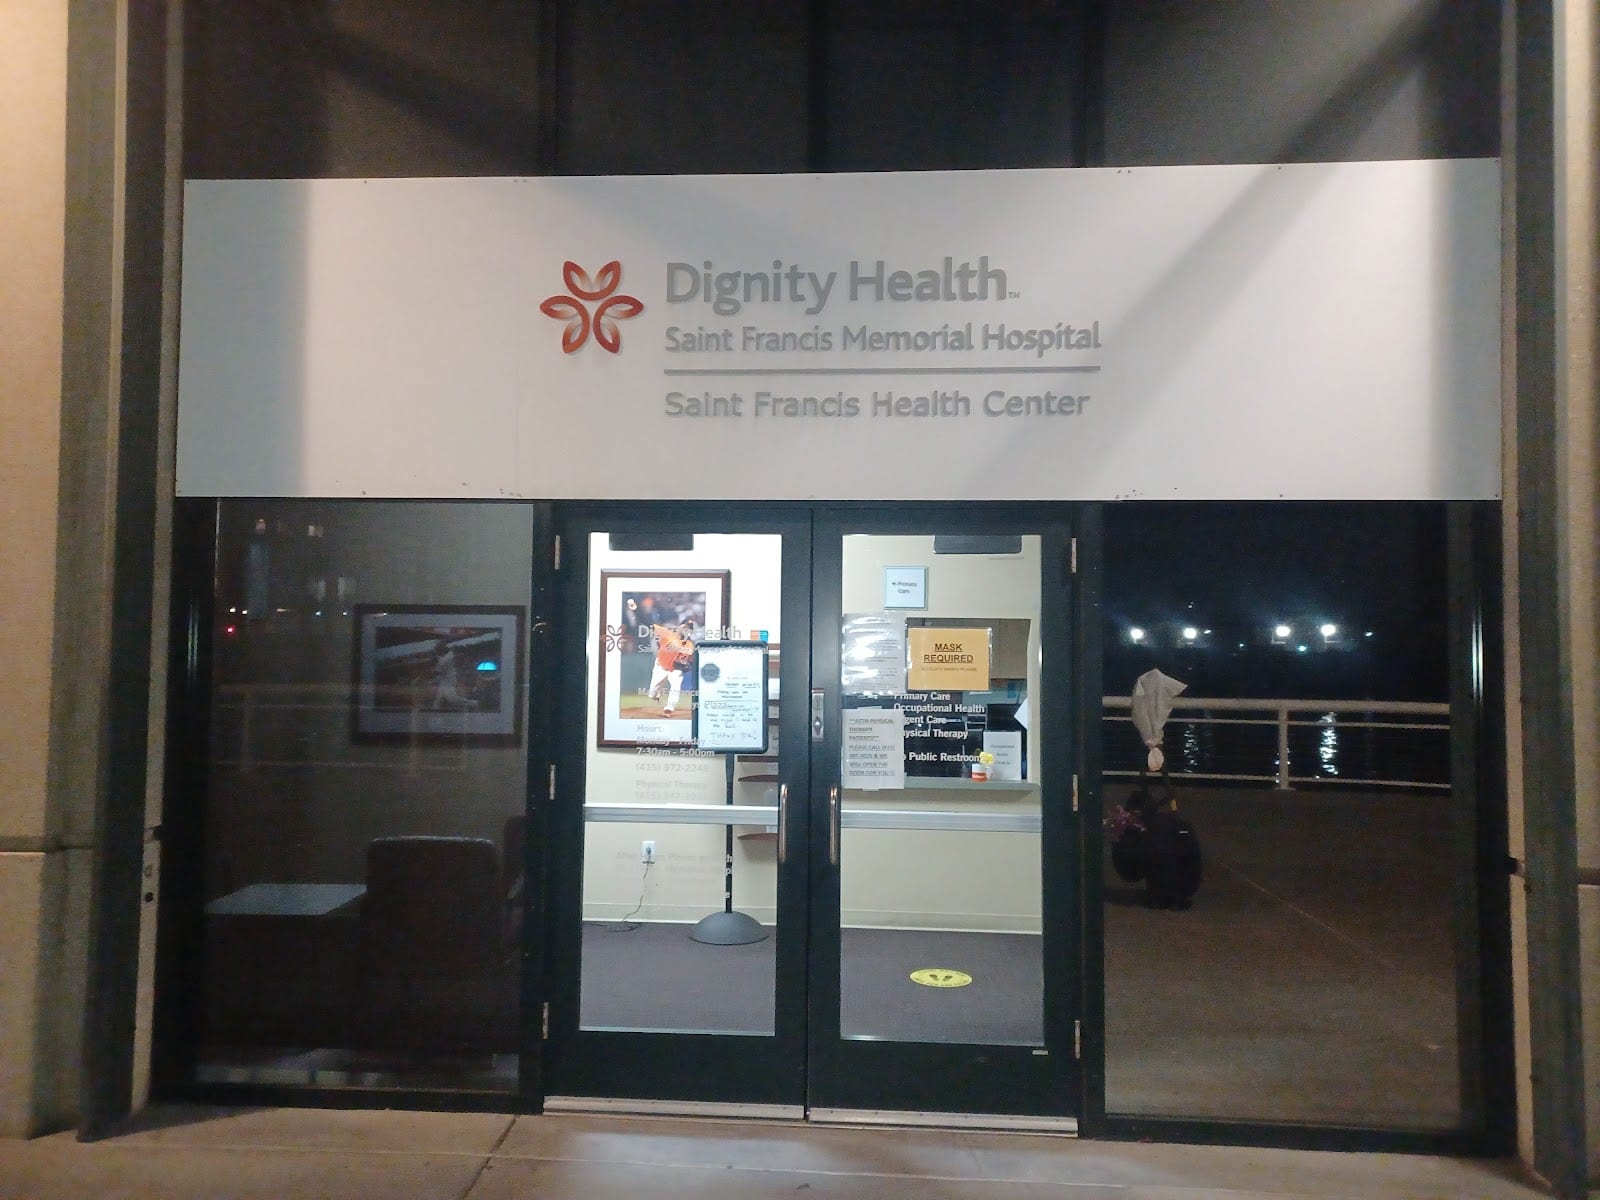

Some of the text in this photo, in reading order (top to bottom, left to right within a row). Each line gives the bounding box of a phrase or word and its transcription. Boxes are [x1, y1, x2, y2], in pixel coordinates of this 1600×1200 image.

[666, 258, 838, 316] Dignity
[849, 256, 1009, 303] Health
[664, 321, 1102, 357] Saint Francis Memorial Hospital
[664, 389, 1091, 418] Saint Francis Health Center
[934, 643, 963, 652] MASK
[923, 654, 974, 664] REQUIRED
[894, 692, 951, 702] Primary Care
[893, 703, 985, 713] Occupational Health
[904, 715, 947, 725] gent Care
[904, 728, 968, 739] ysical Therapy
[679, 747, 715, 758] 5:00pm
[908, 752, 938, 761] Public
